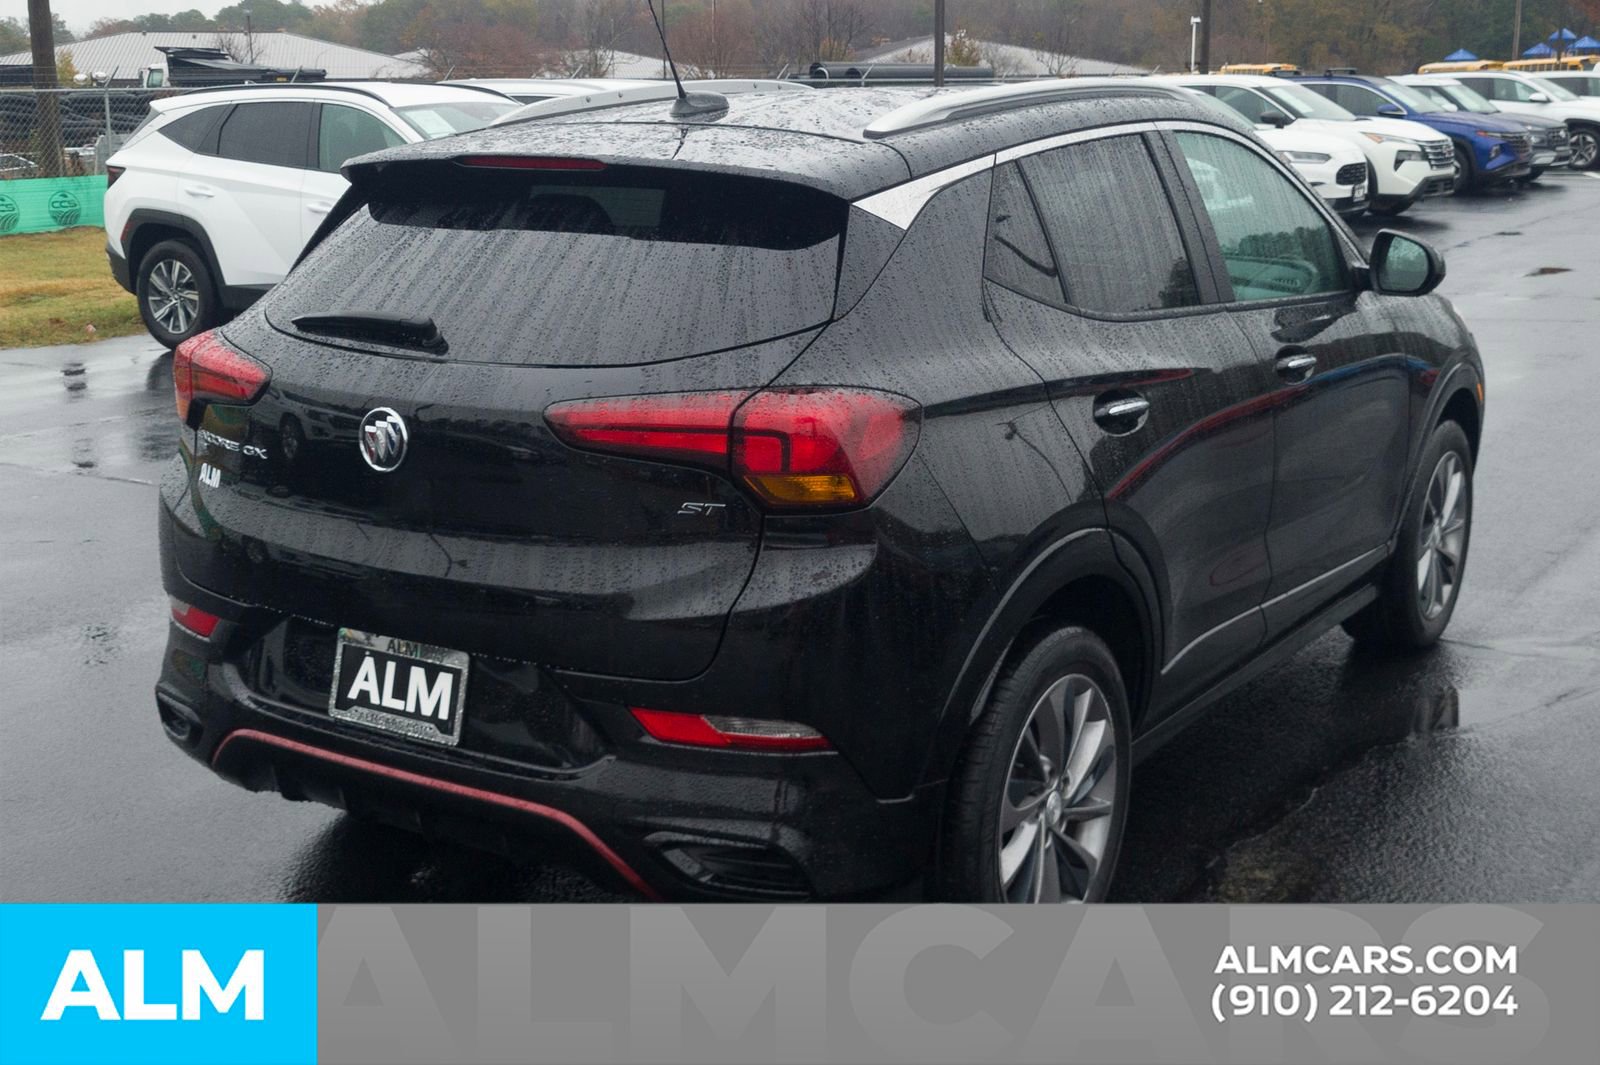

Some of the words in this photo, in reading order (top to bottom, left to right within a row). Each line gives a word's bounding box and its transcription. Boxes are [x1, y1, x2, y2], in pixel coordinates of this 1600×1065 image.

[243, 445, 268, 459] GX
[199, 462, 221, 488] ALM
[677, 502, 726, 516] ST
[347, 656, 453, 720] ALM
